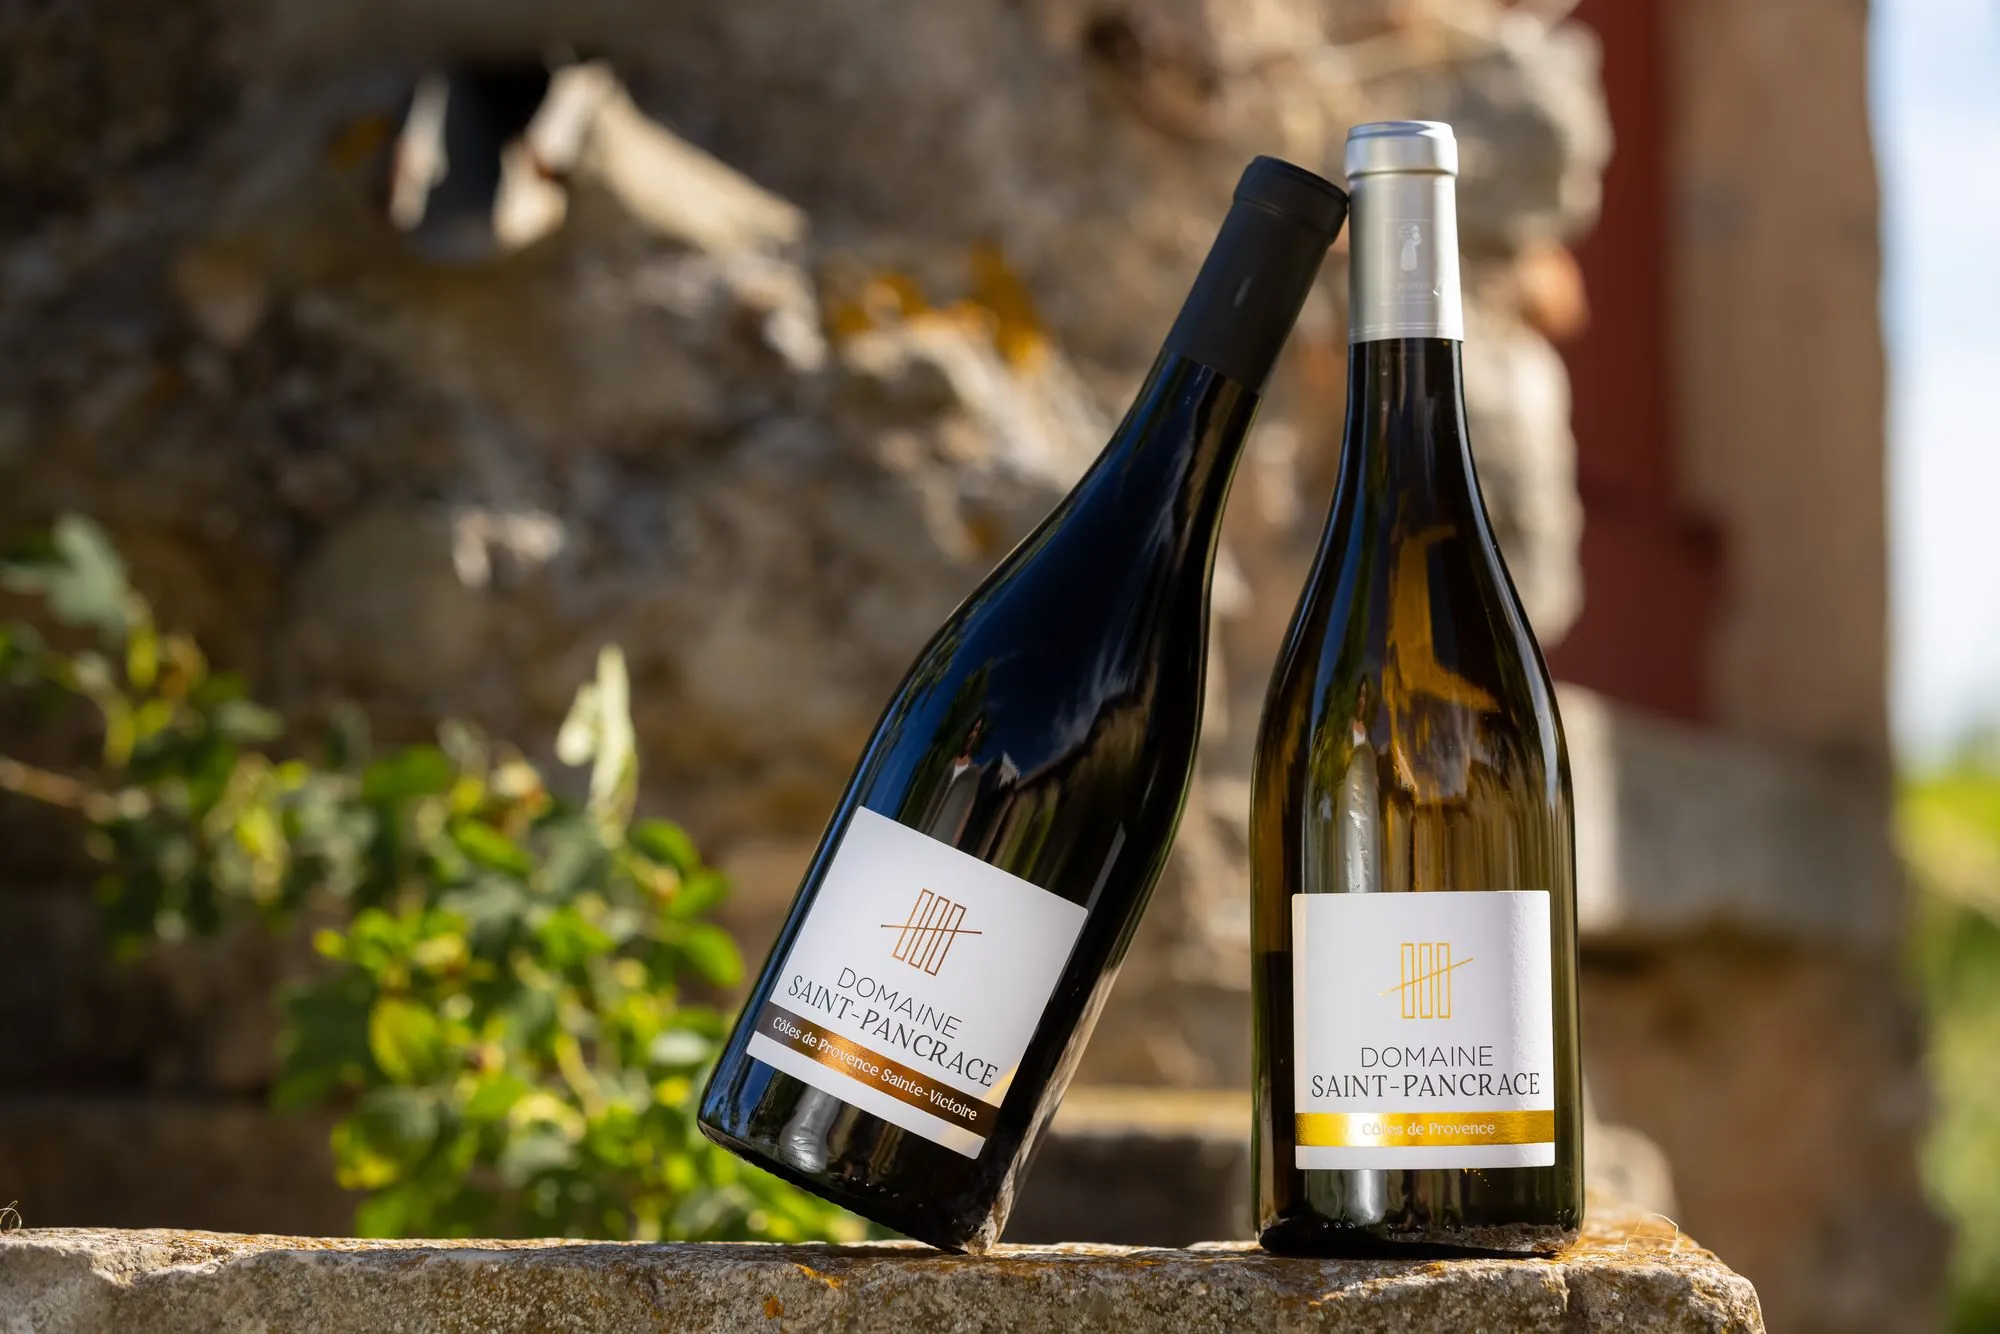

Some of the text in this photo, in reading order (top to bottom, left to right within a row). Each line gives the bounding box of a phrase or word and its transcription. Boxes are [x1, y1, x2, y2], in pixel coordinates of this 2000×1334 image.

[837, 967, 962, 1039] DOMAINE
[788, 975, 998, 1087] SAINT-PANCRACE
[773, 1017, 978, 1121] Côtes de Provence Sainte-Victoire
[1361, 1046, 1493, 1067] DOMAINE
[1312, 1073, 1540, 1098] SAINT-PANCRACE
[1408, 1122, 1424, 1135] de
[1429, 1122, 1495, 1135] Provence
